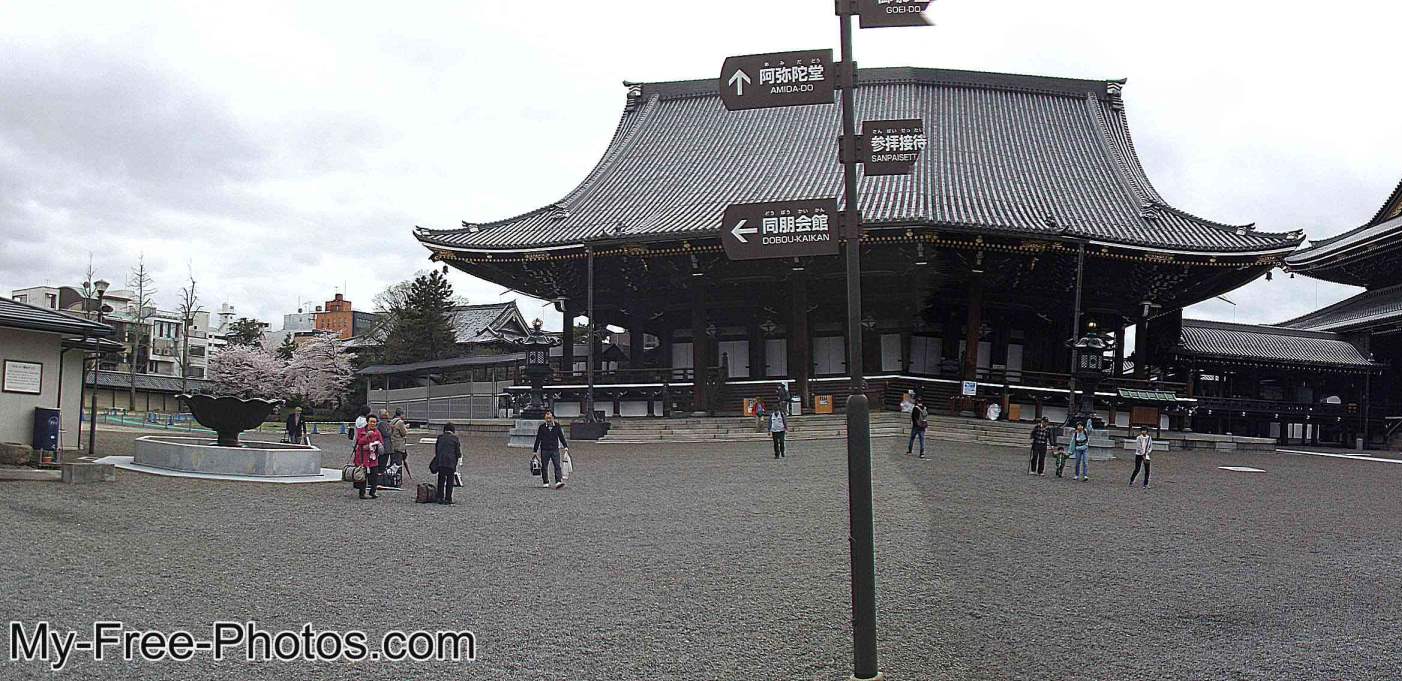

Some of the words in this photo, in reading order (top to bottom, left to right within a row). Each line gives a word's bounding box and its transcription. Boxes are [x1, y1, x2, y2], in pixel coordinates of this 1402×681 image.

[886, 5, 921, 14] GOEI-DO
[759, 64, 825, 85] 阿弥陀堂
[770, 84, 814, 94] AMIDA-DO
[871, 134, 927, 152] 参拝接待
[762, 214, 829, 234] 同朋会館
[762, 234, 830, 245] DOBOU-KAIKAN
